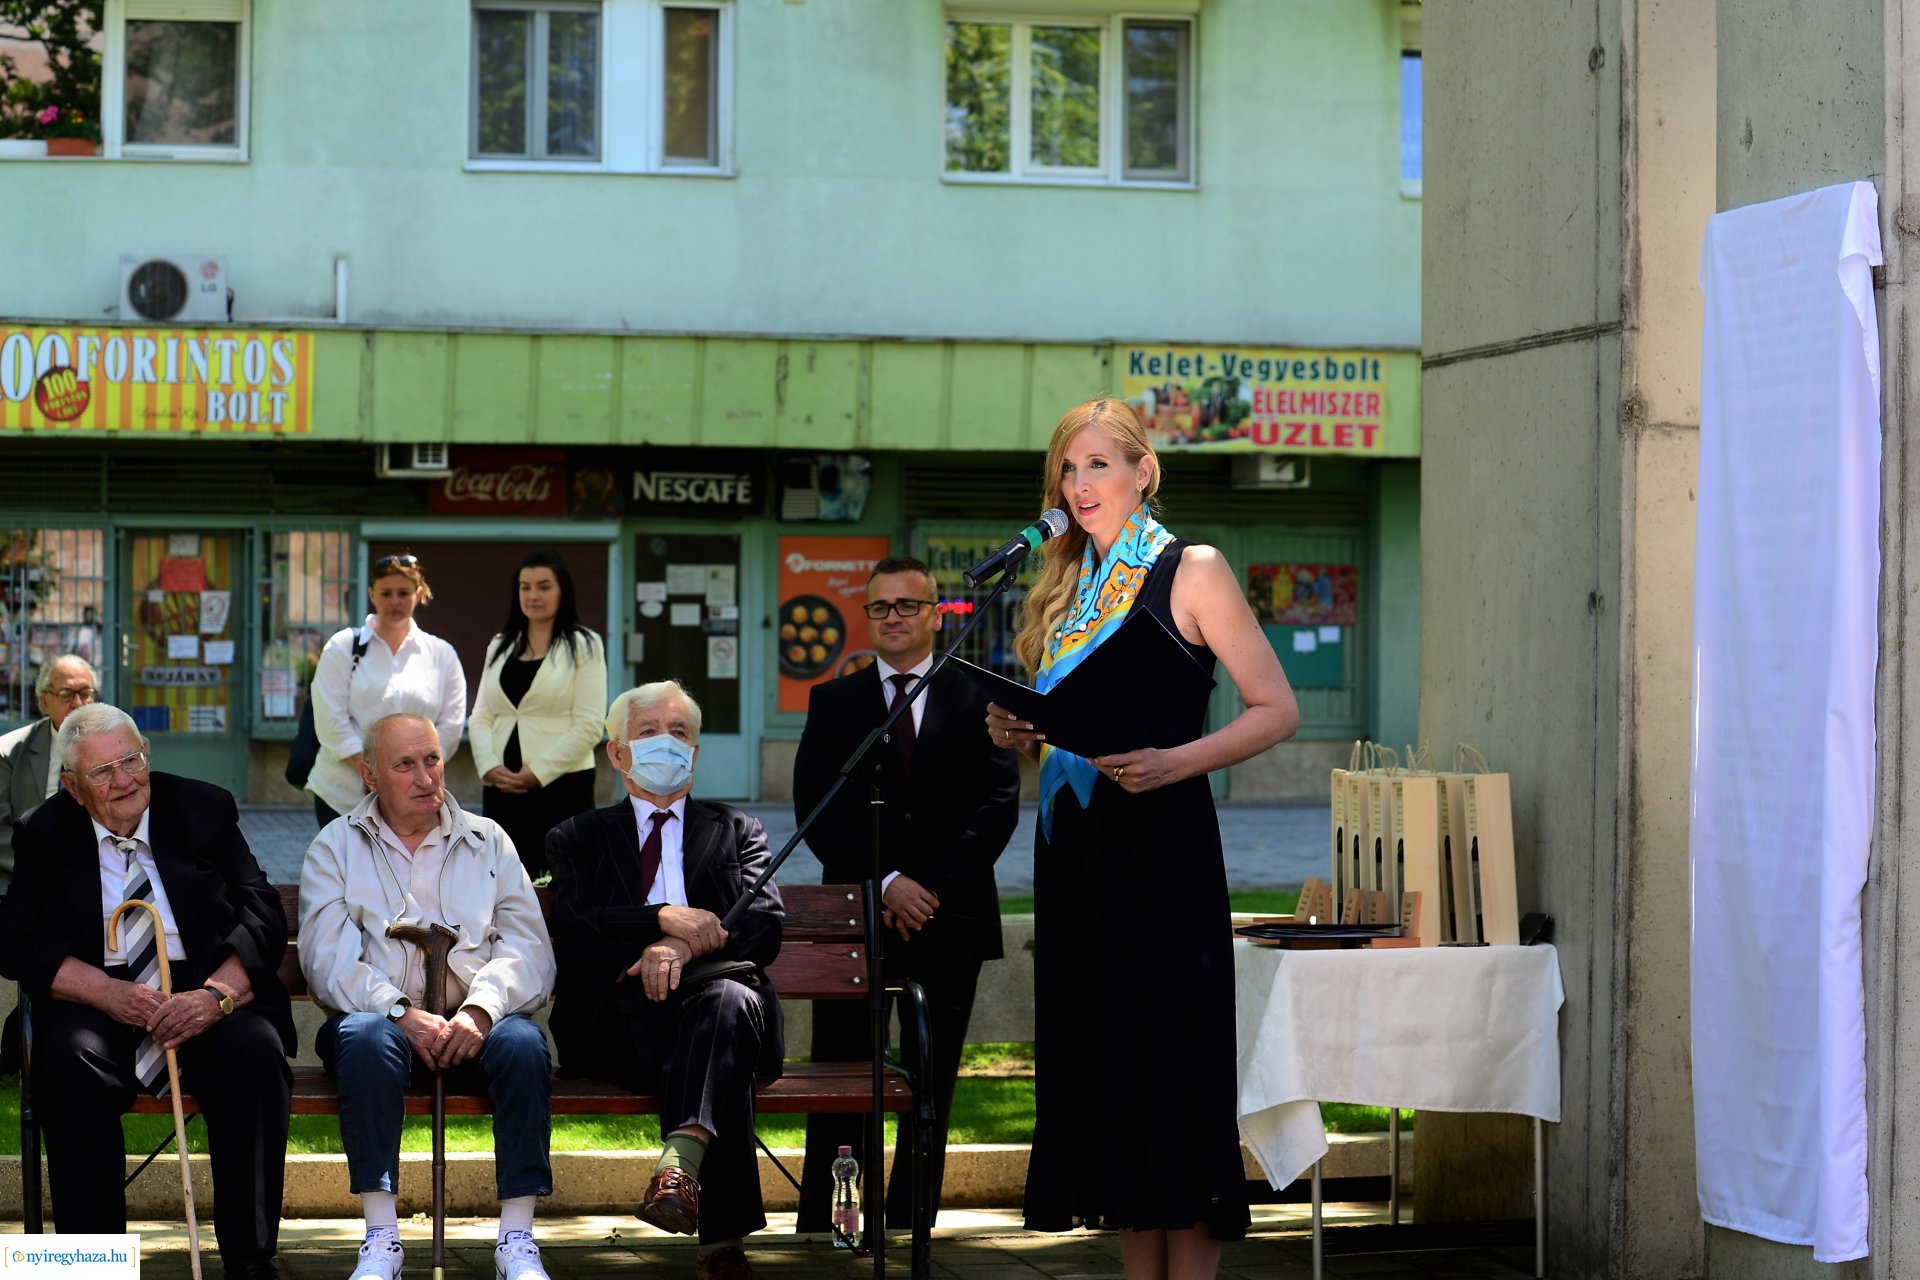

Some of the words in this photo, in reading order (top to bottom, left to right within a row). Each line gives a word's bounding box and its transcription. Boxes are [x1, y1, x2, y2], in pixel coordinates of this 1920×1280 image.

[201, 283, 217, 293] LG
[0, 333, 71, 402] 00
[76, 335, 294, 387] FORINTOS
[1129, 350, 1382, 382] Kelet-Vegyesbolt
[43, 369, 77, 400] 100
[206, 391, 288, 425] BOLT
